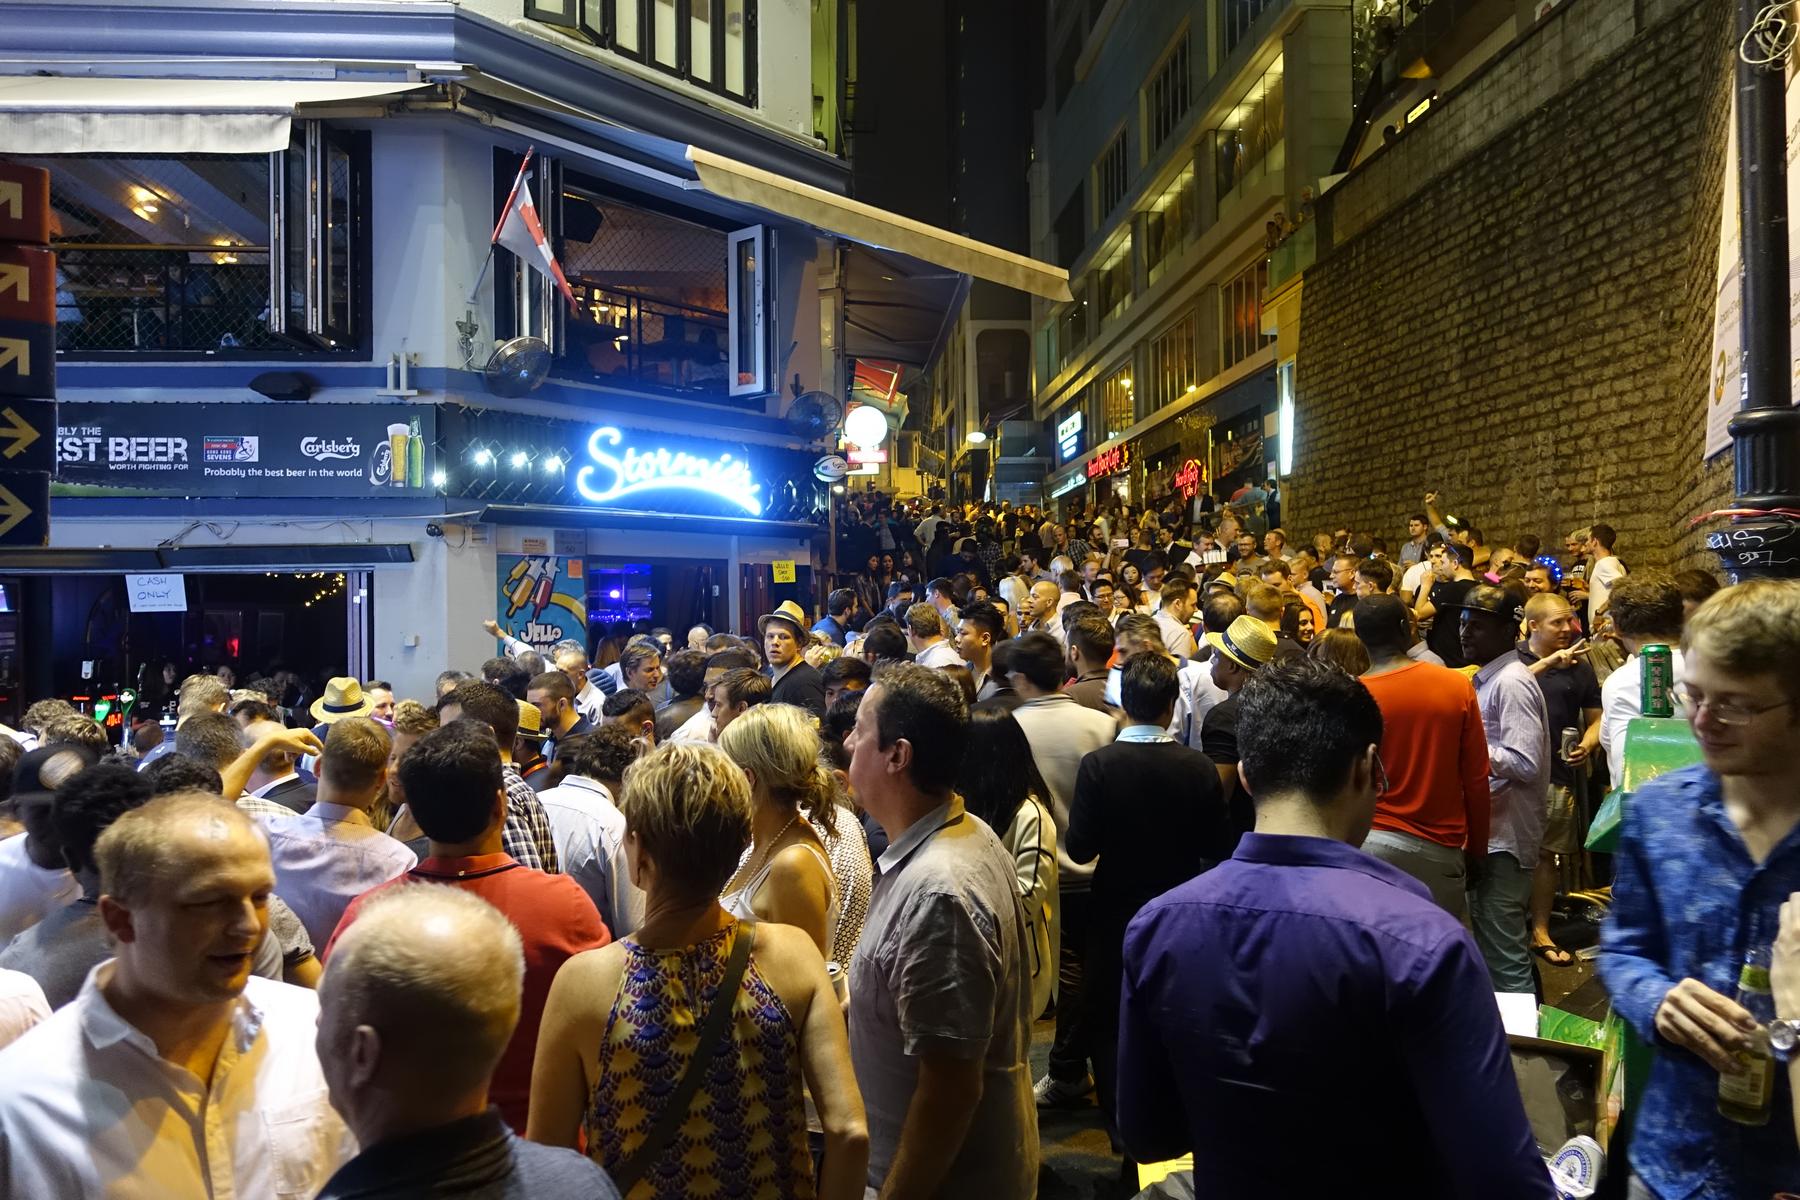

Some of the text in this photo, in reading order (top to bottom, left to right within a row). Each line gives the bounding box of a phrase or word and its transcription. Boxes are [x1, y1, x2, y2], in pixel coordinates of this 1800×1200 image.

[81, 427, 101, 436] THE
[108, 437, 188, 462] BEER
[300, 436, 360, 461] Carlsberg
[109, 463, 189, 471] WORTH FIGHTING FOR
[204, 467, 363, 478] Probably the best beer in the world
[137, 577, 167, 586] CASH
[137, 589, 172, 600] ONLY
